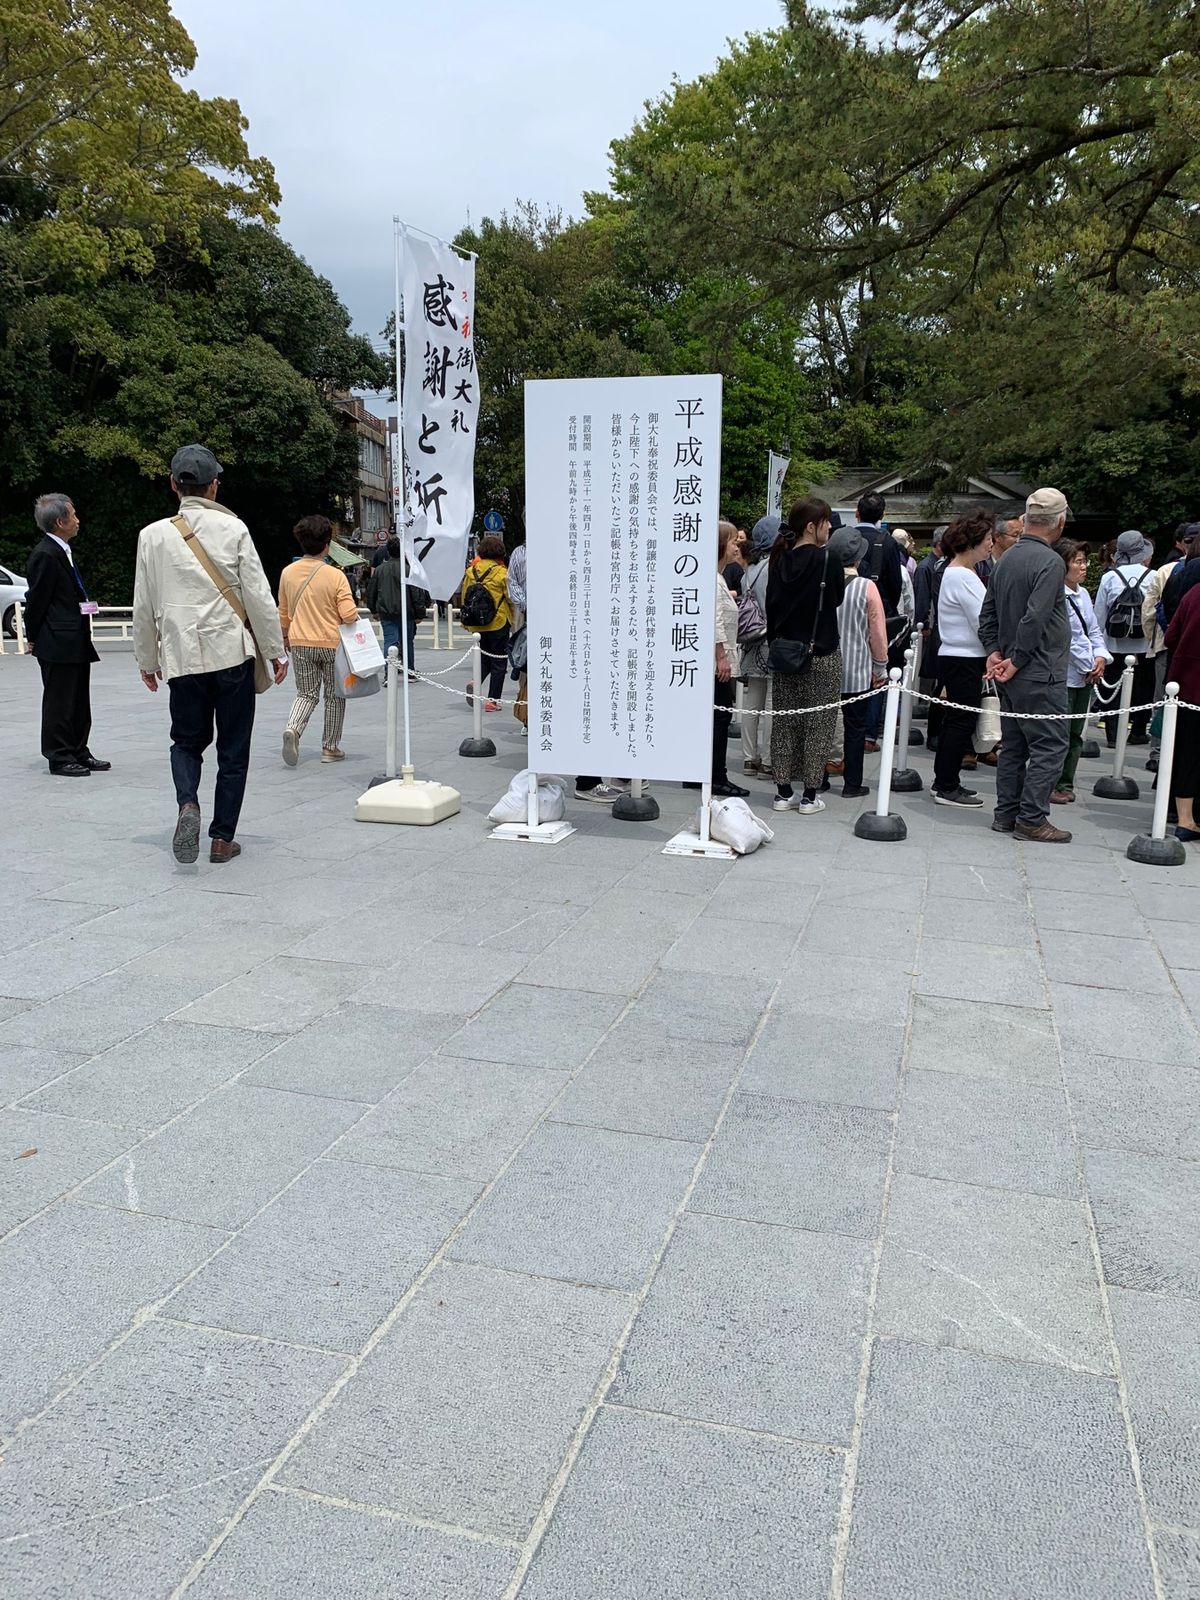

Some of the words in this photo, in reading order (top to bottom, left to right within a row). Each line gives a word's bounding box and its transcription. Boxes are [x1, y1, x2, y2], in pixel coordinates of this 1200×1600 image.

[568, 415, 577, 451] 受付時間
[582, 415, 592, 451] 開設期間
[670, 398, 704, 688] 平成感謝の記帳所
[539, 636, 553, 752] 御大礼奉祝委員会
